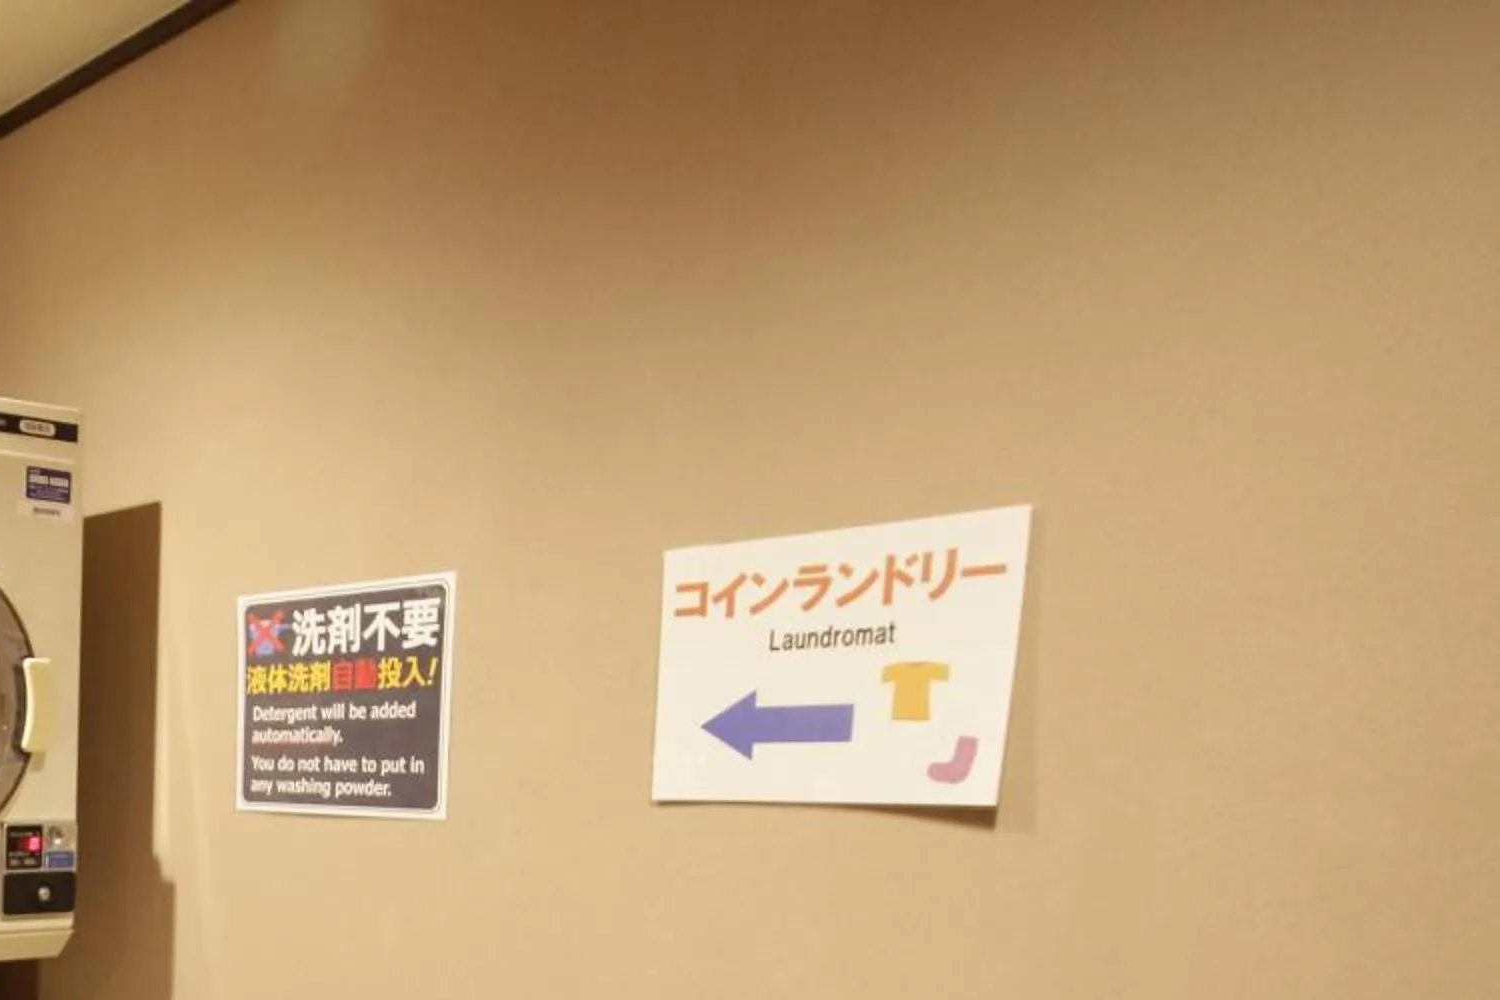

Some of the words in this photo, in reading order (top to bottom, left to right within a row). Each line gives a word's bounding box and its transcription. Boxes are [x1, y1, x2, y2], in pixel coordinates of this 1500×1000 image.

[674, 547, 1007, 619] コインランドリー
[291, 597, 442, 657] 洗剤不要
[768, 622, 897, 652] Laundromat
[253, 703, 317, 724] Detergent
[321, 703, 345, 719] will
[349, 702, 367, 719] be
[371, 701, 417, 719] added
[251, 725, 344, 747] automatically.
[251, 756, 273, 772] You
[277, 756, 294, 771] do
[298, 756, 320, 772] not
[324, 756, 358, 772] have
[362, 756, 377, 773] to
[381, 757, 407, 776] put
[410, 755, 425, 773] in
[250, 779, 273, 796] any
[277, 778, 331, 798] washing
[335, 780, 392, 798] powder.
